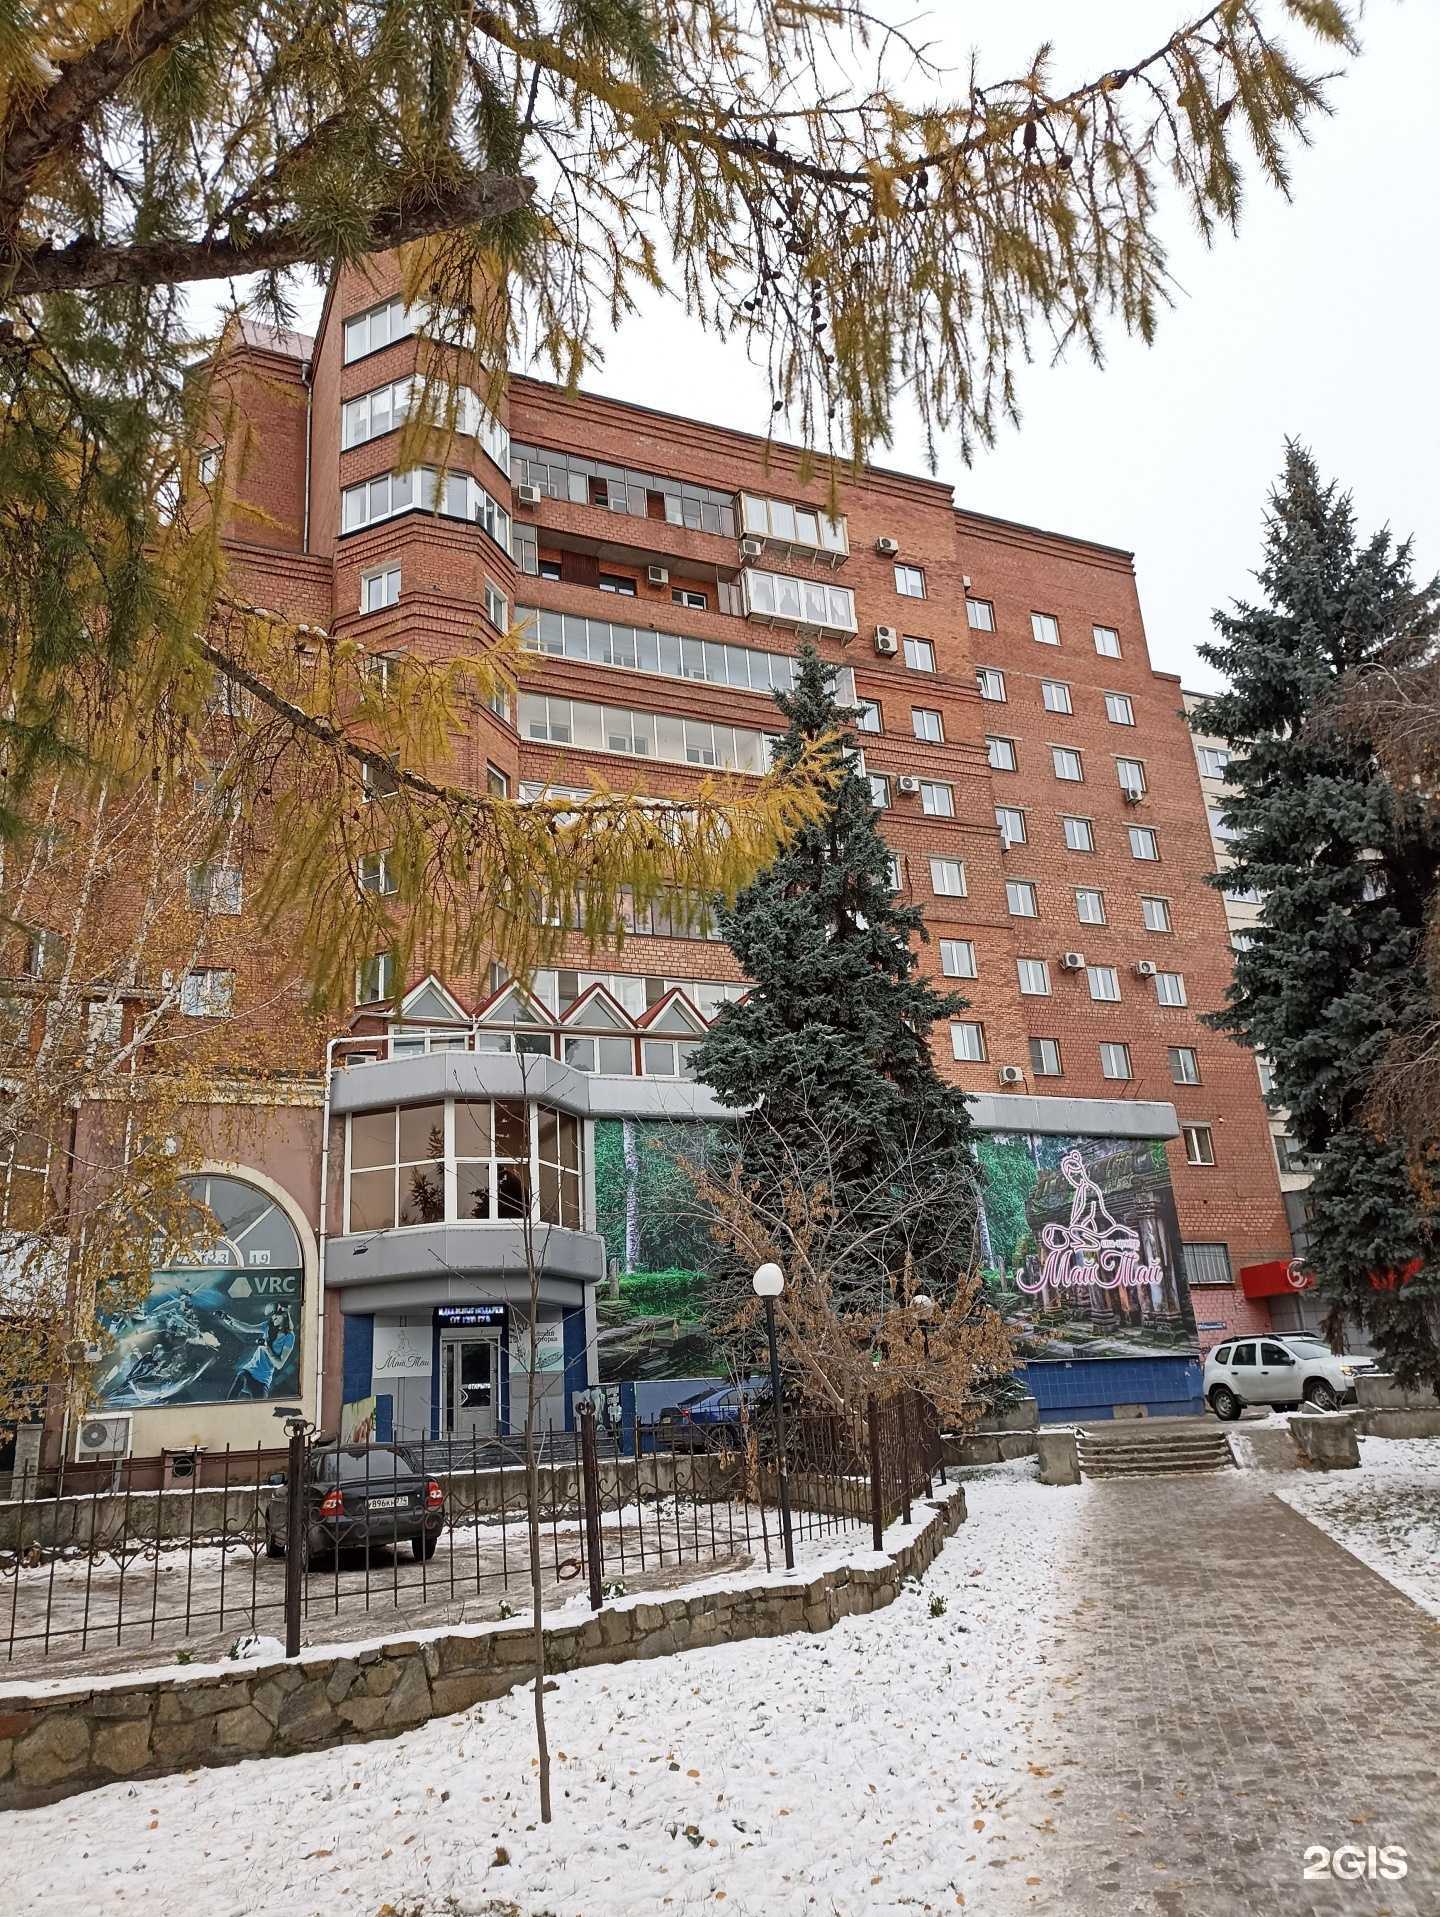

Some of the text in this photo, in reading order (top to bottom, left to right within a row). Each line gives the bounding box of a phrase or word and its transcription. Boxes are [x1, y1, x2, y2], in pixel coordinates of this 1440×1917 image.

[254, 1276, 296, 1293] VRC
[1016, 1250, 1164, 1293] Май Тай
